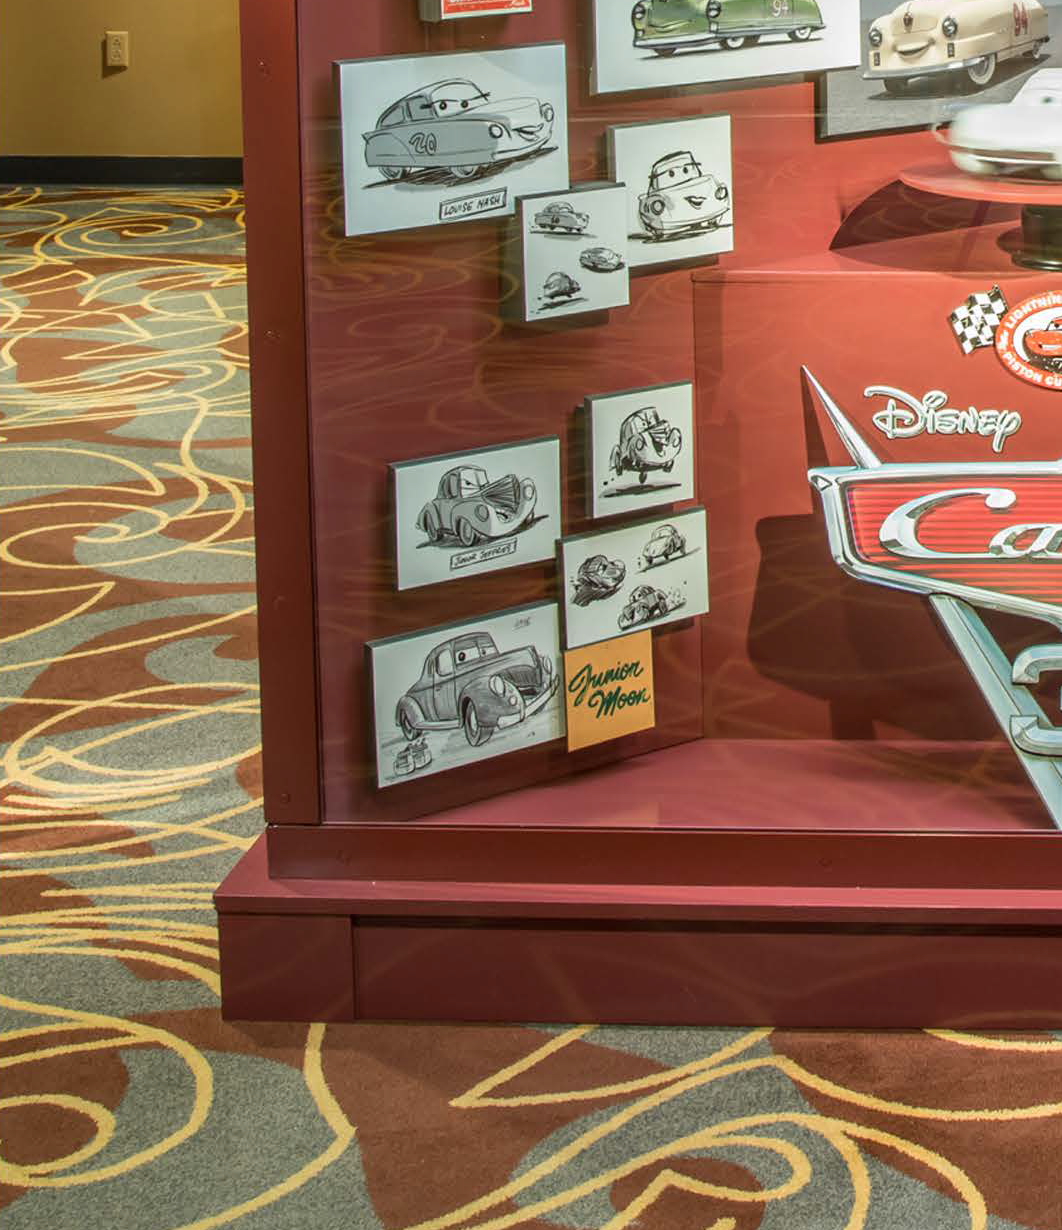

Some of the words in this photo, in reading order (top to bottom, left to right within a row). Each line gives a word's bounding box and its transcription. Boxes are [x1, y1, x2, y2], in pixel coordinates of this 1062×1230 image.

[409, 131, 438, 156] 20
[443, 201, 473, 216] LOUISE
[476, 195, 501, 209] NASH
[1002, 352, 1042, 382] PISTON
[864, 385, 1022, 453] Disney
[568, 660, 644, 707] Junior
[588, 685, 651, 719] Moon
